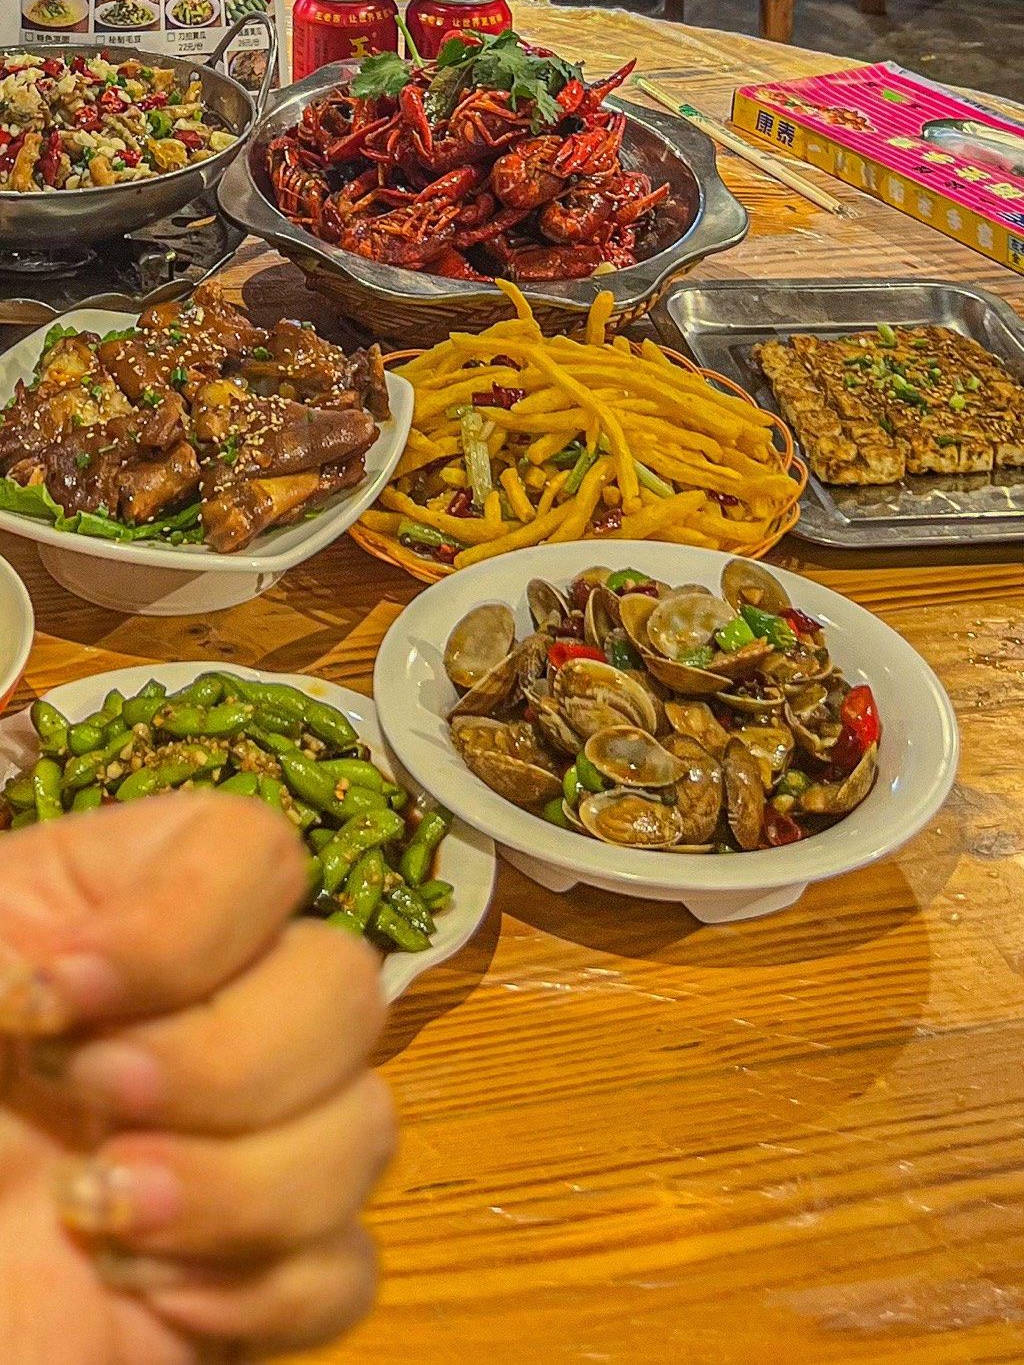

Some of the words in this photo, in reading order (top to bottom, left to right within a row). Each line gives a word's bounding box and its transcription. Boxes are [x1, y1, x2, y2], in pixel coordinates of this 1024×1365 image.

[315, 11, 341, 23] 王老吉
[755, 109, 795, 148] 康泰
